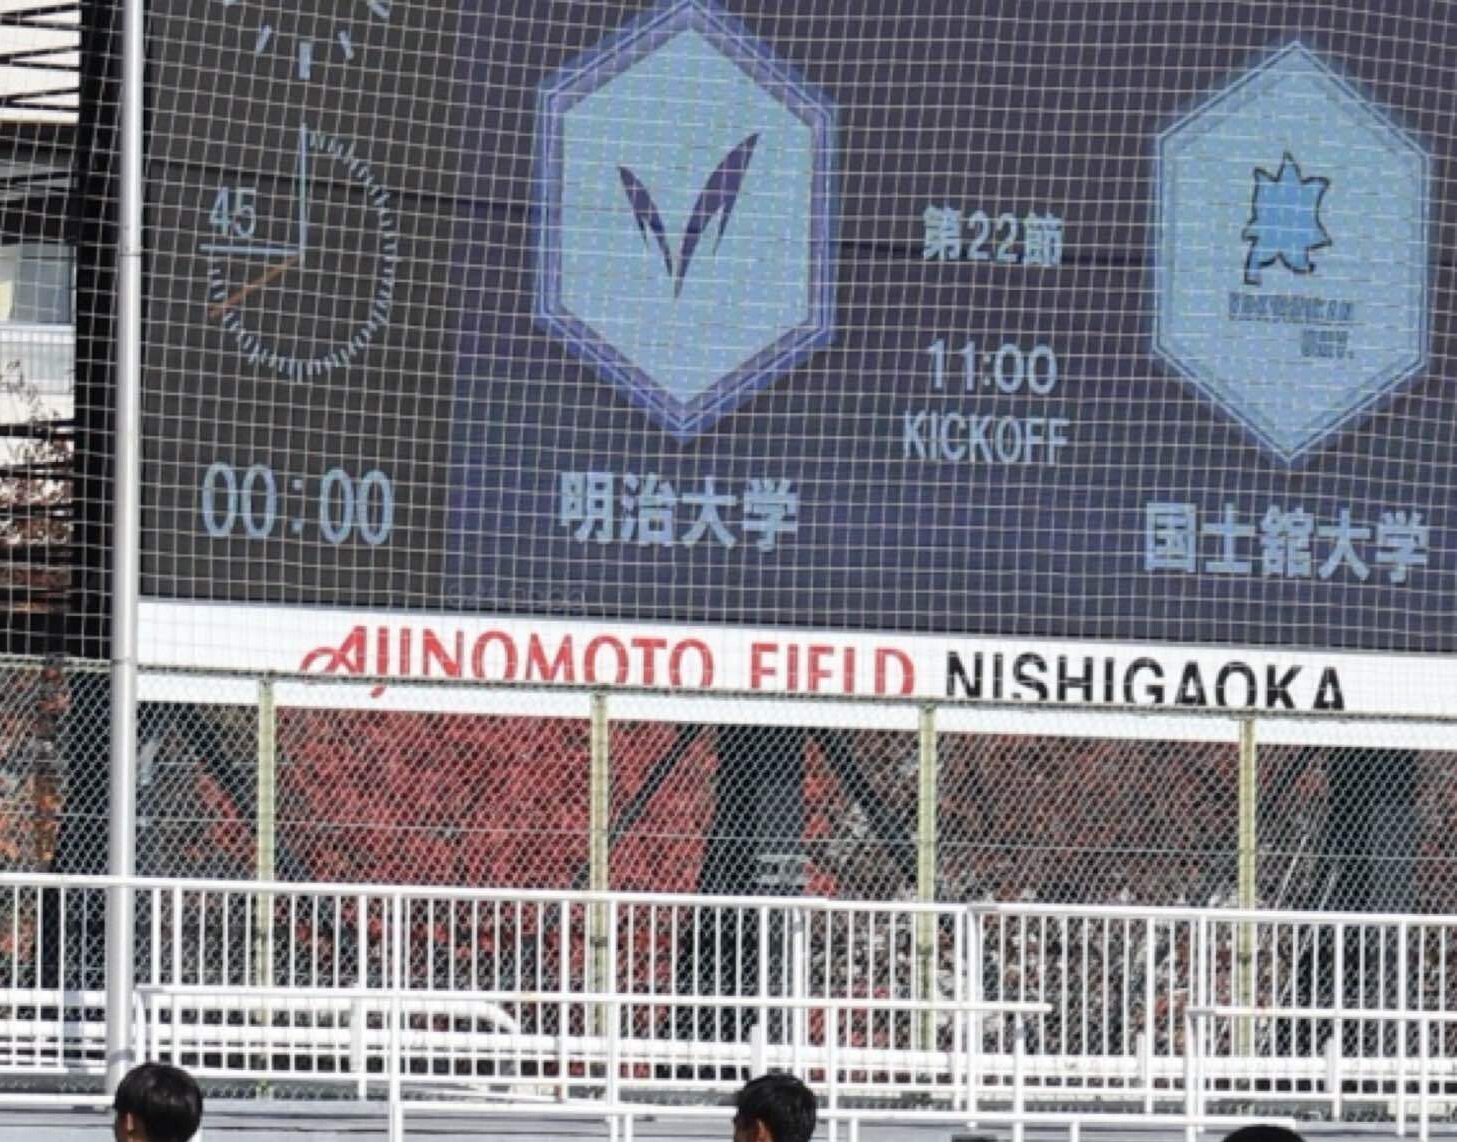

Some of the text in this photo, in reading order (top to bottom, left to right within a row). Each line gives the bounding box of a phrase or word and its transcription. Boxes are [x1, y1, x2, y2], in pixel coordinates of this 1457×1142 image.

[209, 187, 257, 237] 45
[922, 204, 1064, 267] 第22節
[927, 339, 1058, 395] 11:00
[903, 411, 1071, 465] KICKOFF
[201, 461, 394, 545] 00:00
[558, 471, 801, 552] 明治大学
[298, 625, 715, 699] AJINOMOTO
[944, 650, 1348, 711] NISHIGAOKA
